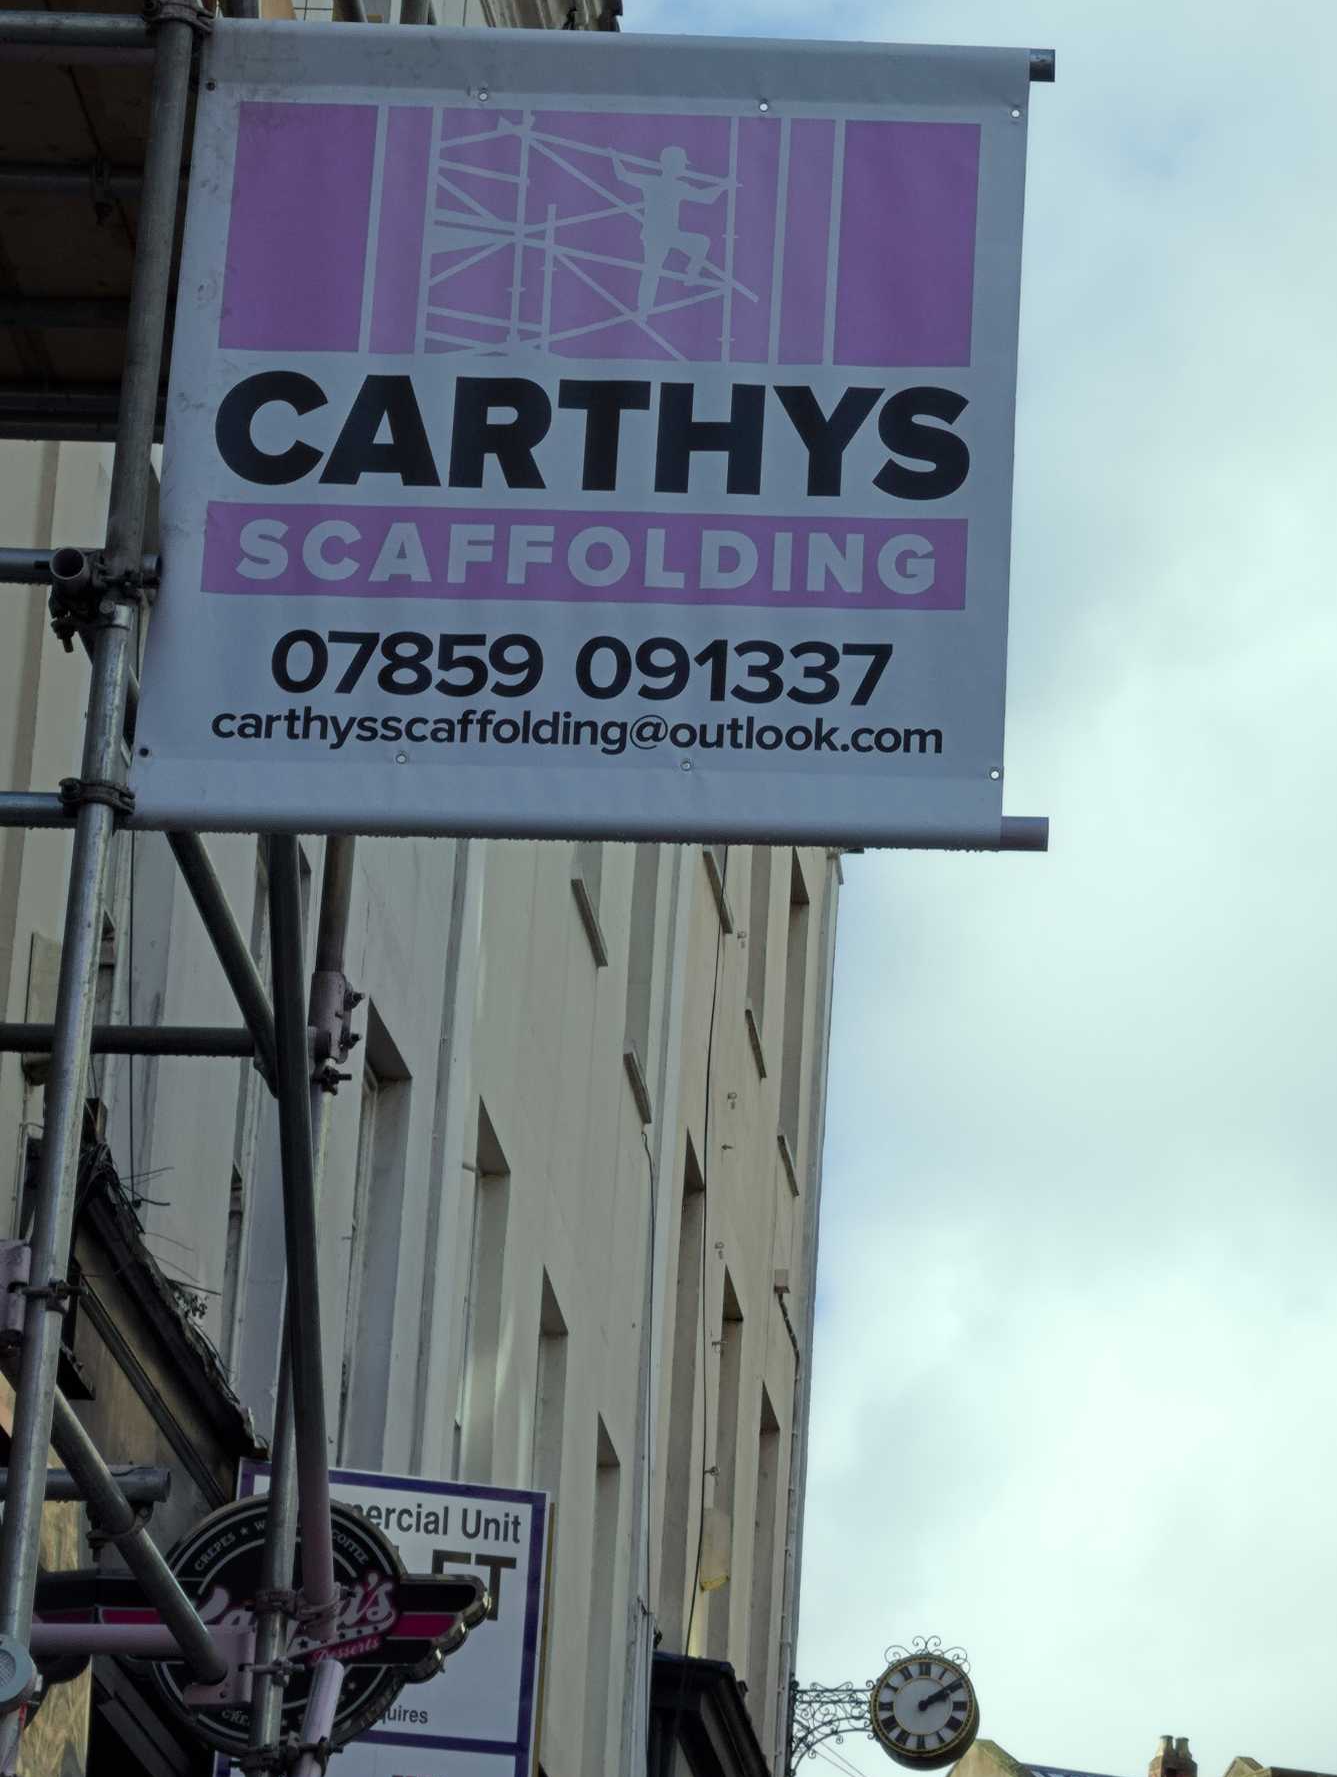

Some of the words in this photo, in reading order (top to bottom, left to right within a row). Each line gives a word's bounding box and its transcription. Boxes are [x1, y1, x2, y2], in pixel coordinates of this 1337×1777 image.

[215, 371, 970, 500] CARTHYS
[236, 519, 936, 593] SCAFFOLDING
[271, 629, 543, 698] 07859
[575, 637, 893, 706] 091337
[211, 706, 943, 755] carthysscaffolding@outlook.com
[462, 1508, 521, 1543] Unit
